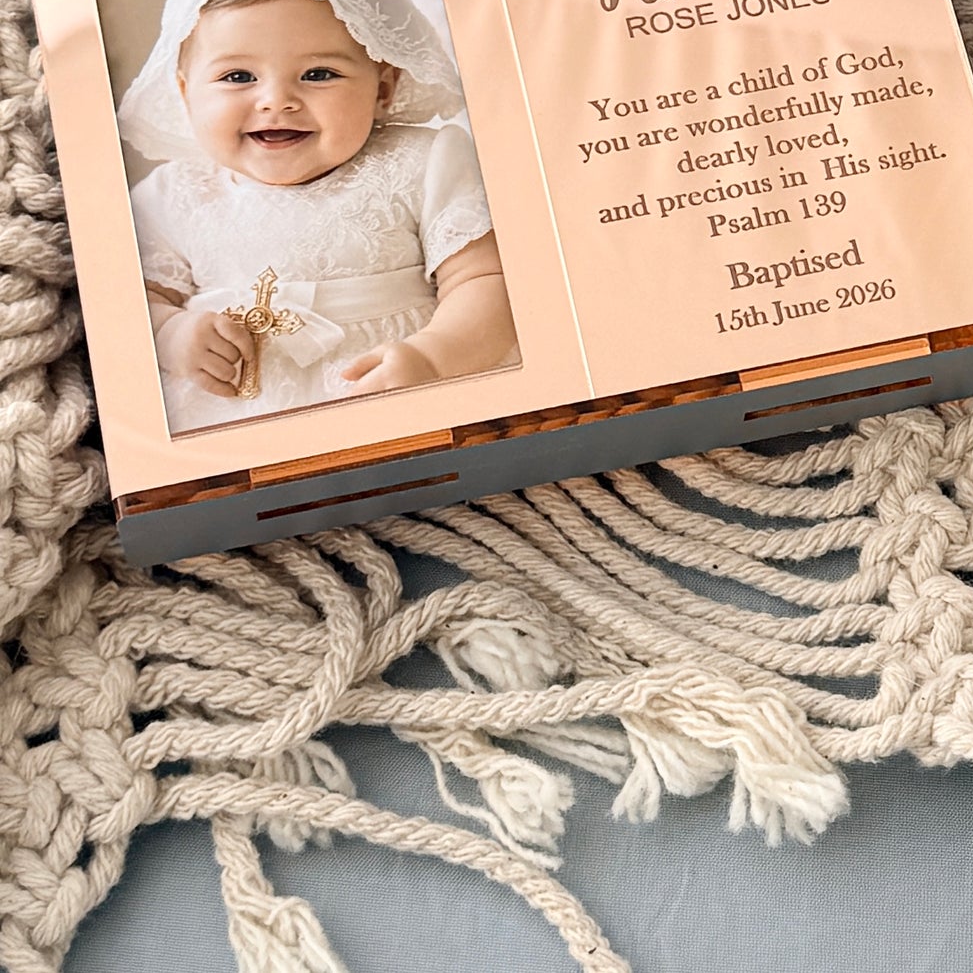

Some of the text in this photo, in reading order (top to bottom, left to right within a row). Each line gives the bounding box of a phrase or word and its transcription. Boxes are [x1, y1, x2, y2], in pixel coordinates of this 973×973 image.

[626, 4, 718, 38] ROSE
[588, 46, 904, 122] You are a child of God,
[578, 76, 934, 163] you are wonderfully made,
[677, 124, 849, 174] dearly loved,
[599, 140, 947, 224] and precious in His sight.
[707, 190, 848, 238] Psalm 139
[725, 239, 865, 290] Baptised
[836, 278, 896, 309] 2026
